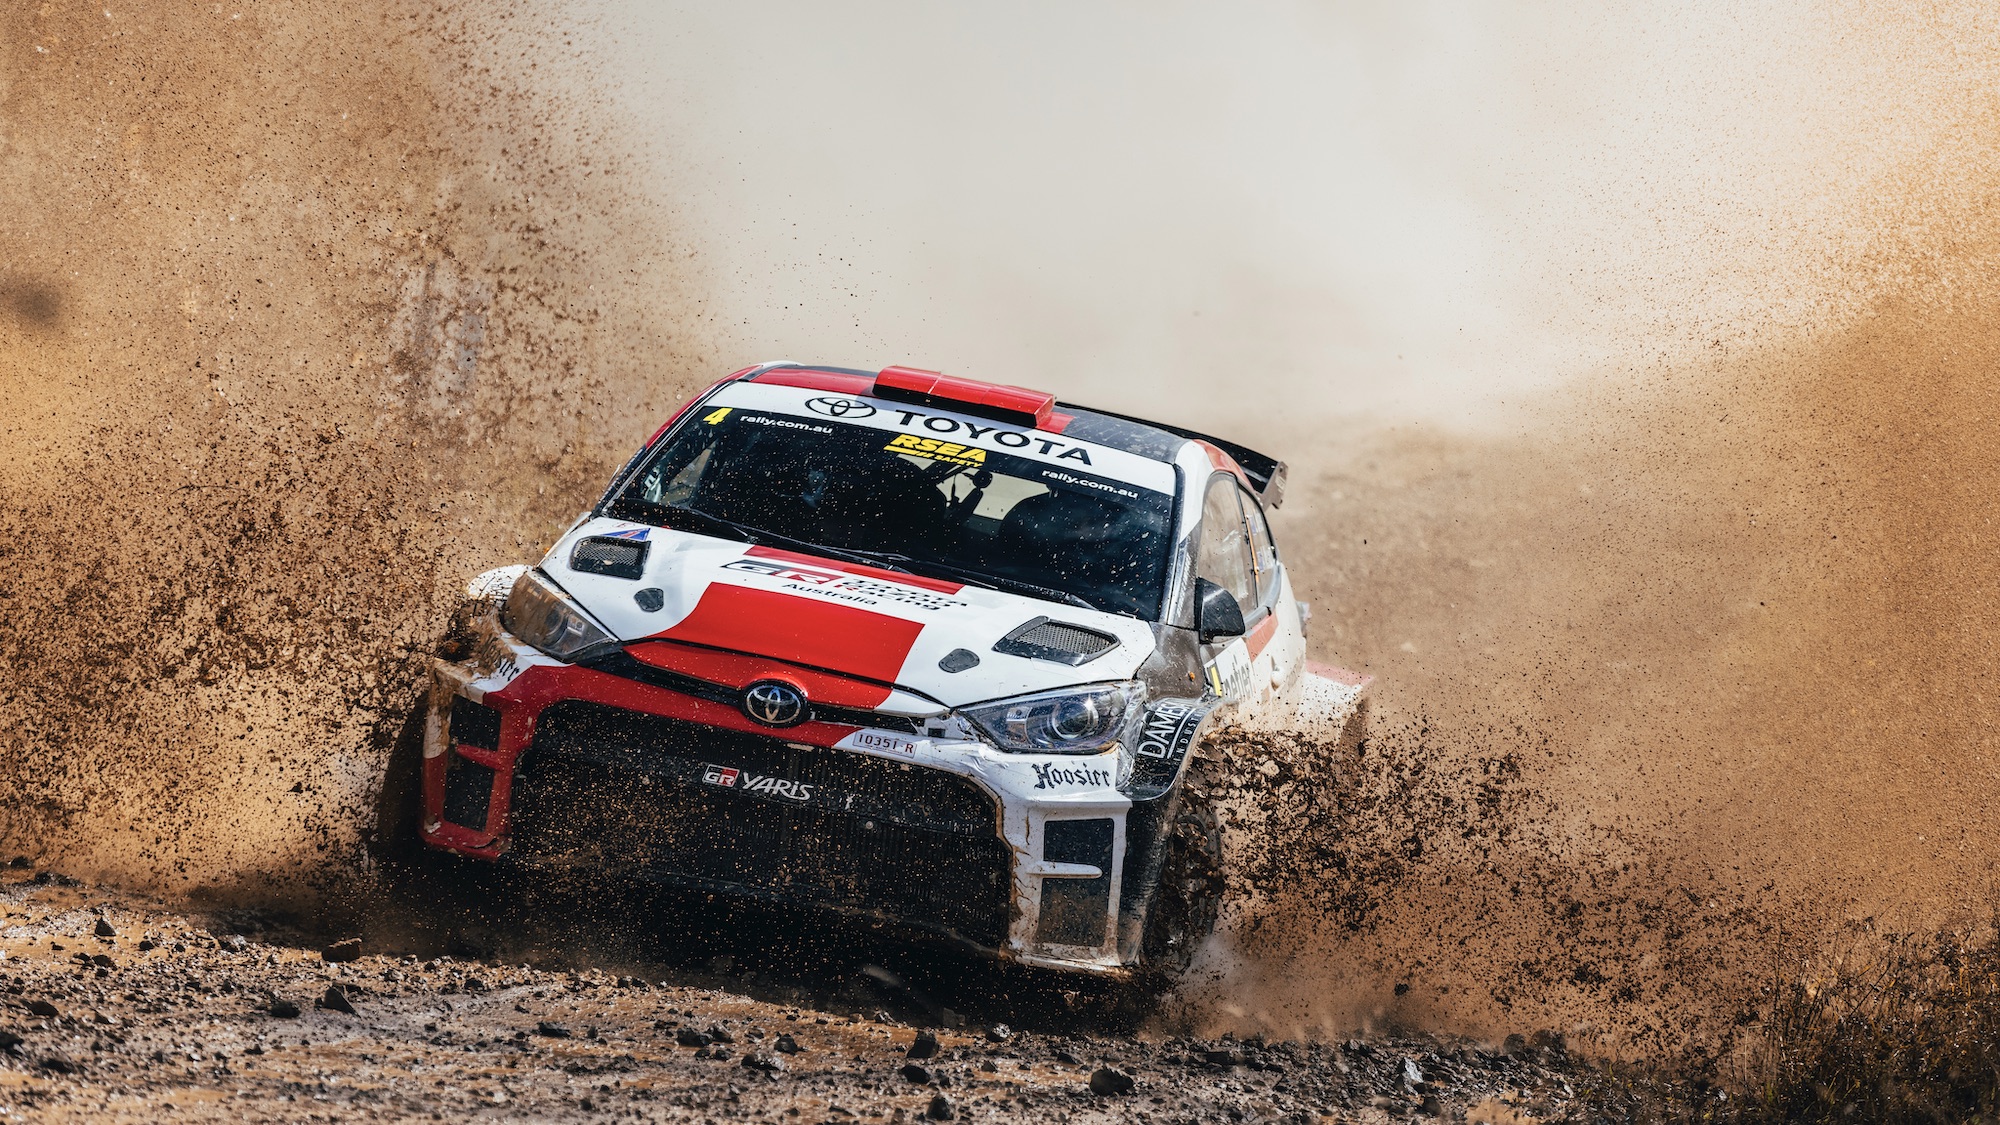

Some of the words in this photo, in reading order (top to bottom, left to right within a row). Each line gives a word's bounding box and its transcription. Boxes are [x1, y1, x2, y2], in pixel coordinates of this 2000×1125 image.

[703, 407, 733, 425] 4
[740, 415, 833, 434] rally.com.au
[890, 434, 987, 462] RSEA
[895, 409, 1093, 467] TOYOTA
[1042, 469, 1138, 499] rally.com.au
[724, 560, 833, 585] GR
[781, 583, 878, 606] Australia
[704, 771, 736, 786] GR
[1031, 761, 1110, 789] Hoosier
